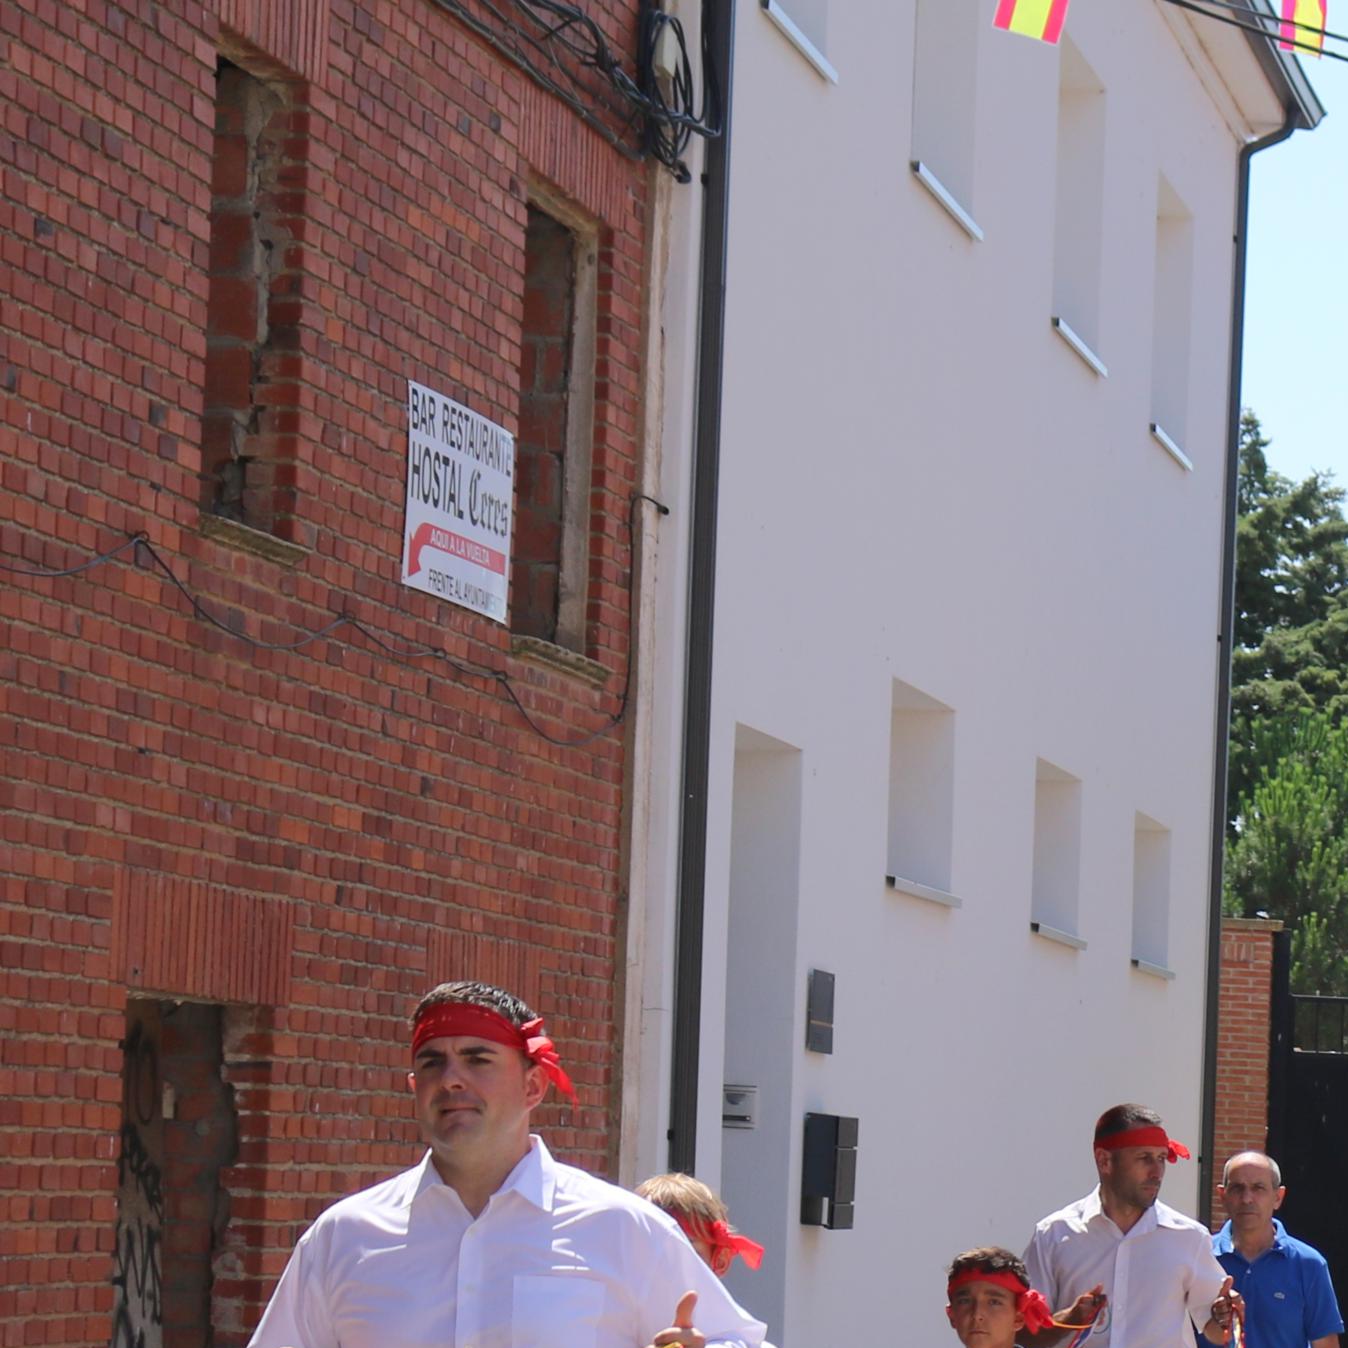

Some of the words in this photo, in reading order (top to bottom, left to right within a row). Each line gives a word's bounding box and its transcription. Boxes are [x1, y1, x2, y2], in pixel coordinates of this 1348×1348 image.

[412, 388, 436, 438] BAR
[442, 403, 511, 477] RESTAURANTE
[411, 441, 464, 519] HOSTAL
[469, 469, 508, 538] Ceres
[456, 537, 466, 555] LA
[429, 568, 453, 596] FRENTE
